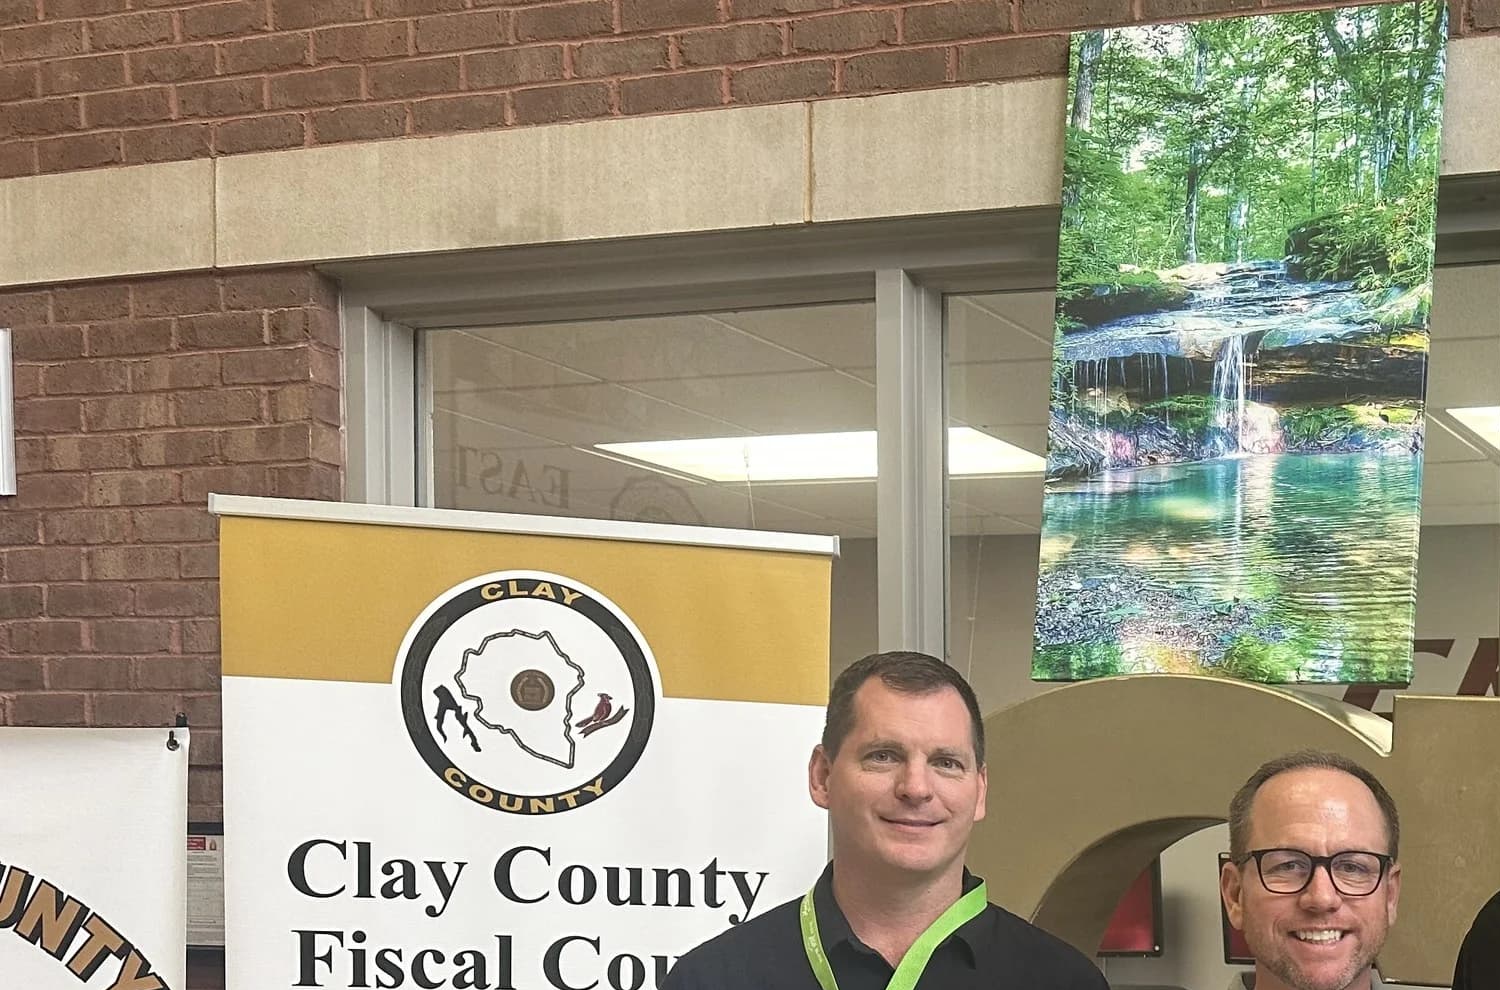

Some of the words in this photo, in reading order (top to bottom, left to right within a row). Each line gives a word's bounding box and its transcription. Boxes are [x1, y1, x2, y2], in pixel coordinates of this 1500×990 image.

[480, 580, 583, 606] CLAY
[444, 766, 607, 814] COUNTY
[287, 838, 469, 919] Clay
[494, 845, 770, 926] County
